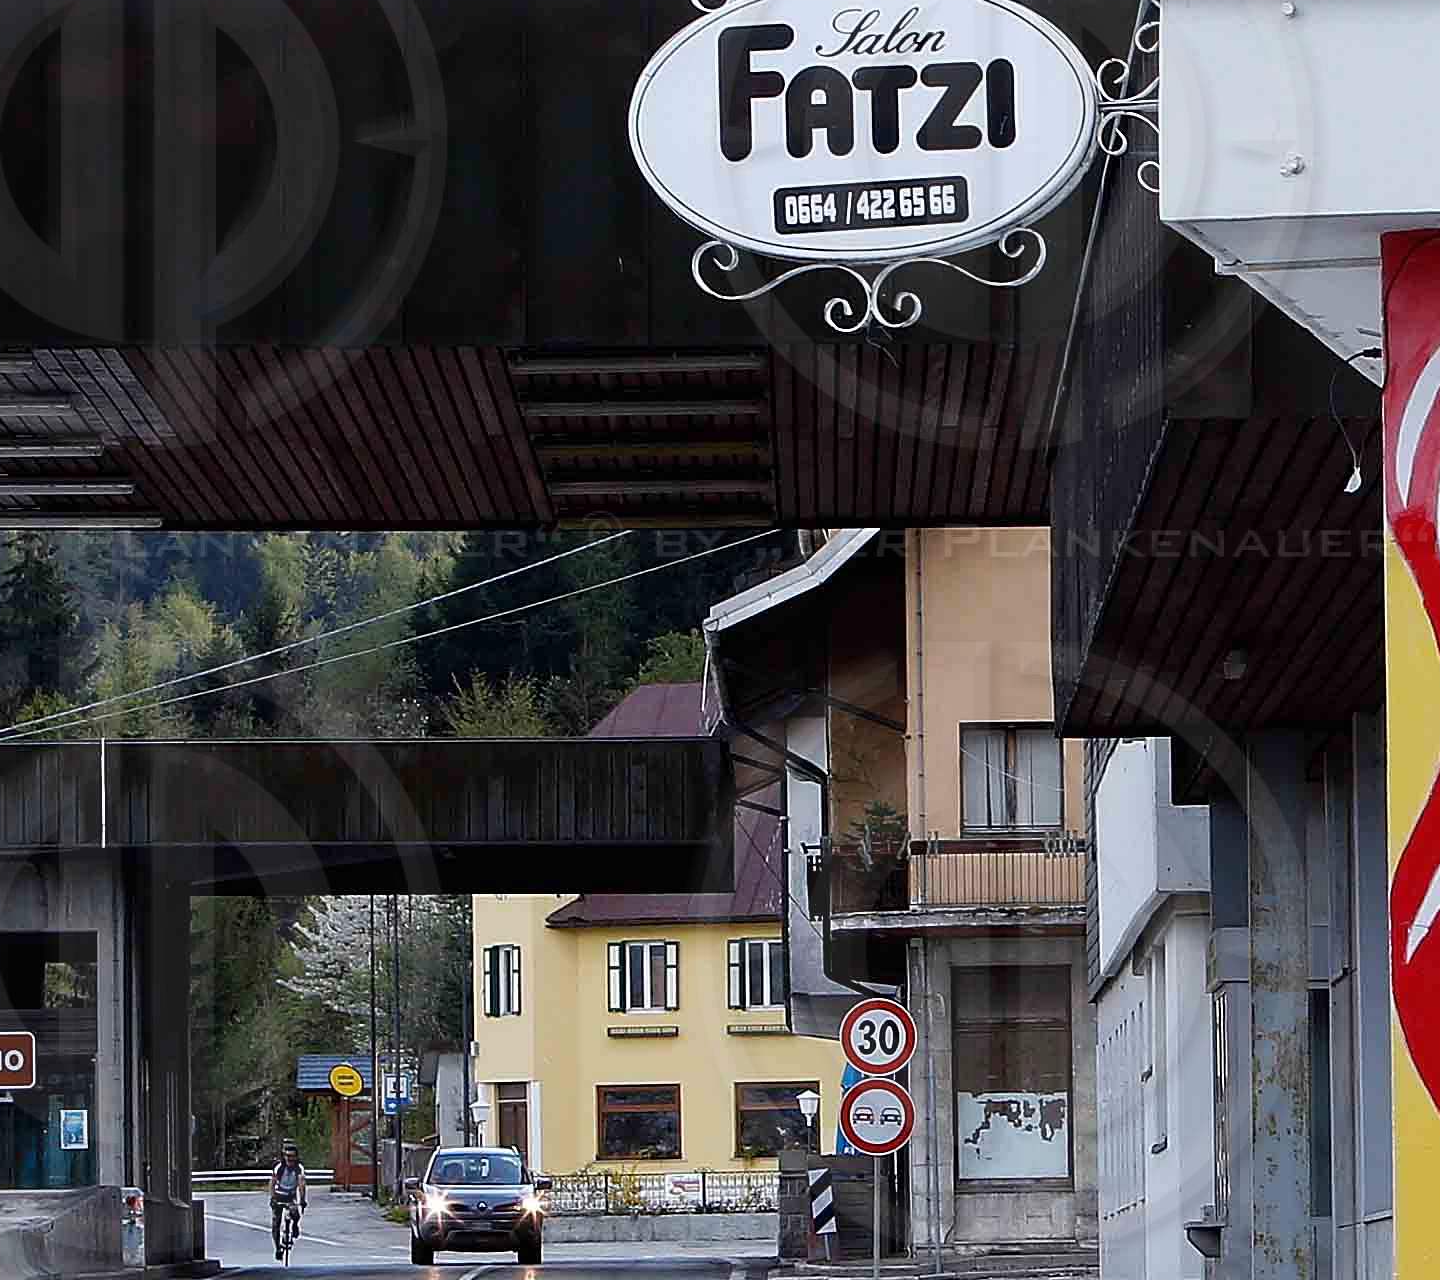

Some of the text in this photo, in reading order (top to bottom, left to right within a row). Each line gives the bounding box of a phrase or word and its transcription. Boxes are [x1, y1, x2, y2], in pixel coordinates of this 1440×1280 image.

[814, 6, 948, 58] Salon
[784, 194, 837, 225] 0664
[899, 190, 927, 219] 65
[929, 187, 956, 216] 66
[857, 1019, 901, 1056] 30
